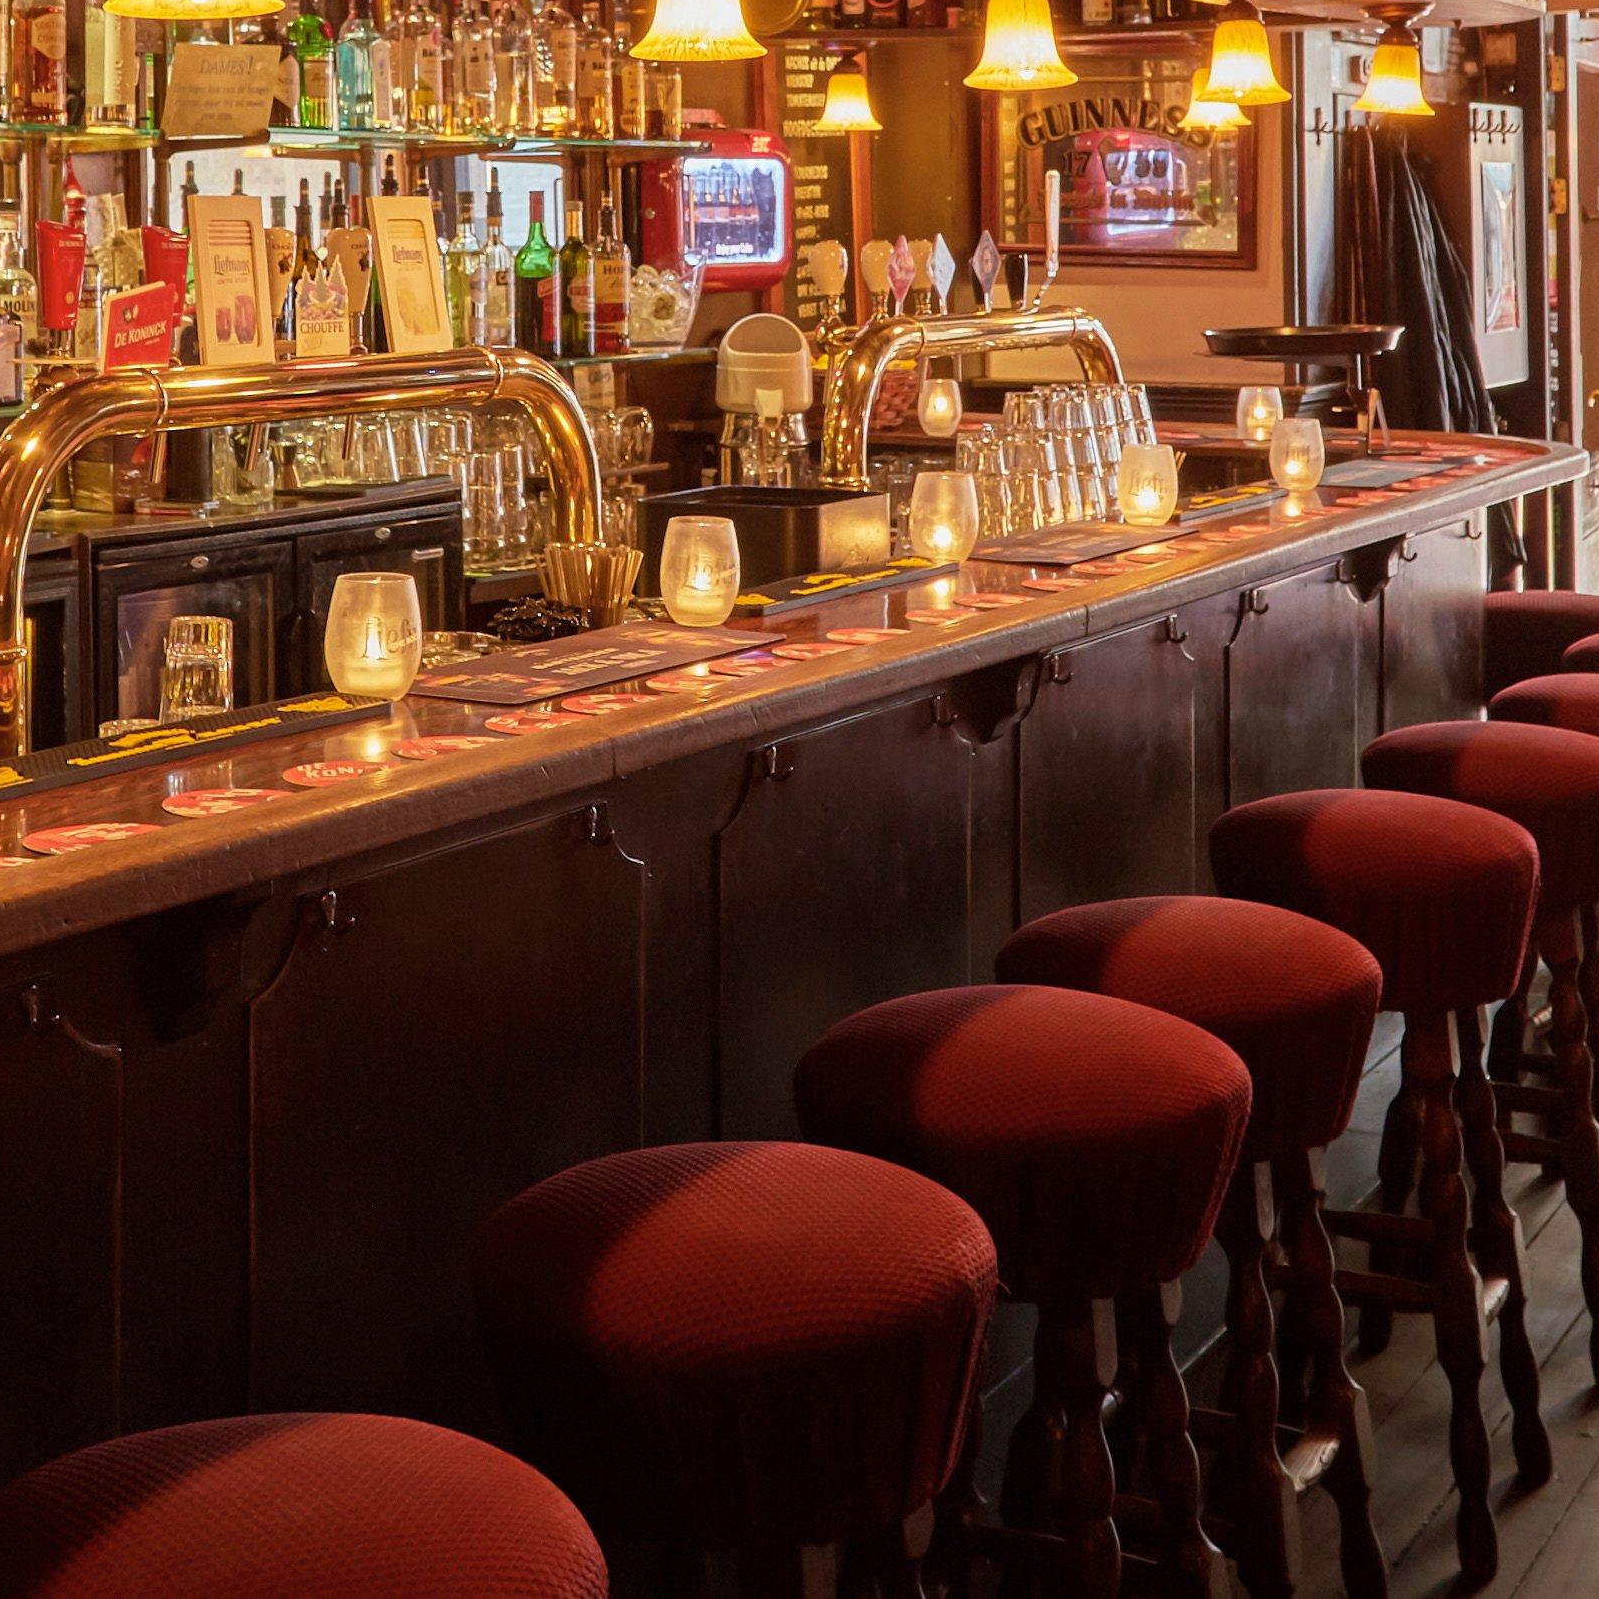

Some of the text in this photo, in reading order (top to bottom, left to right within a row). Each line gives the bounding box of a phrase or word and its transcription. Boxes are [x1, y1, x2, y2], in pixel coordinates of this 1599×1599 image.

[1061, 151, 1090, 178] 17
[213, 254, 251, 276] Liefmans
[392, 244, 424, 265] Liefmans
[114, 320, 167, 349] DE KONINCK
[300, 320, 345, 334] CHOUFFE
